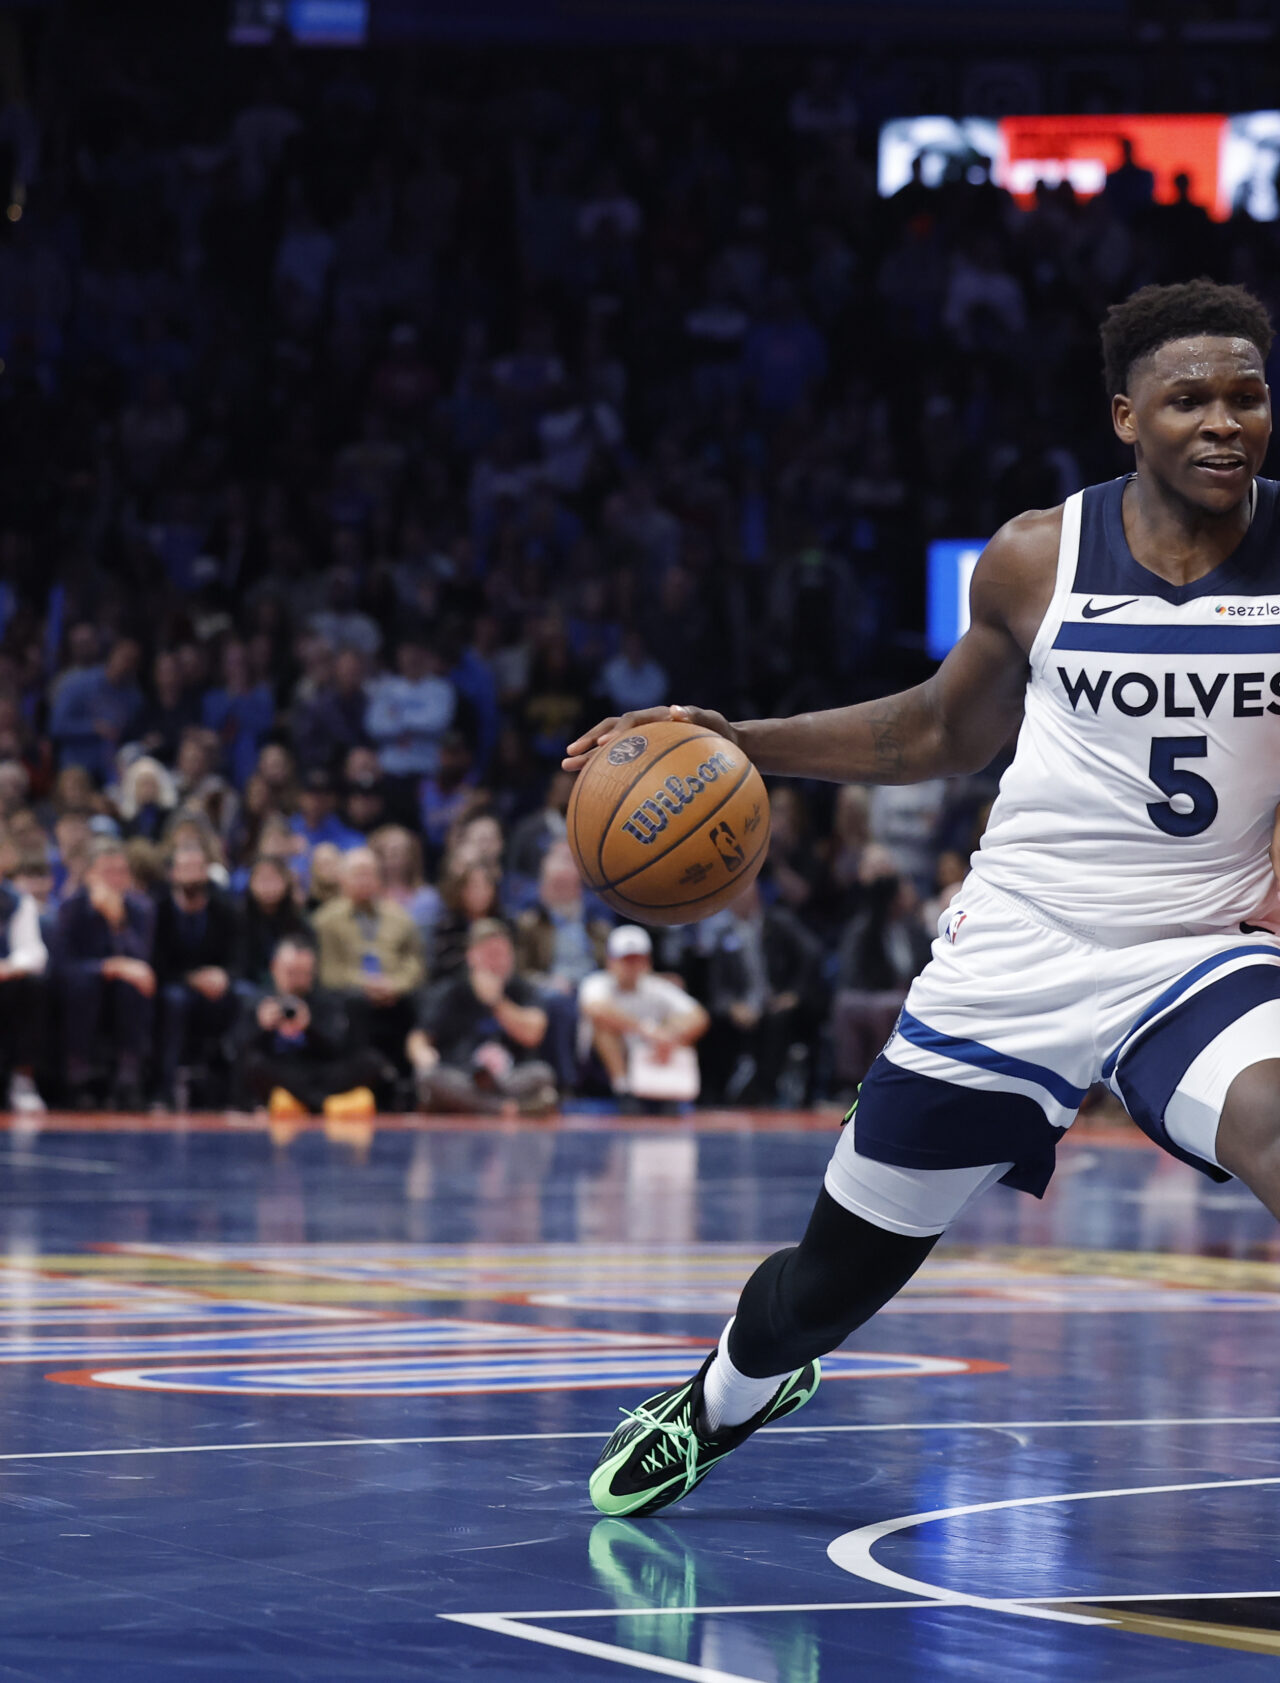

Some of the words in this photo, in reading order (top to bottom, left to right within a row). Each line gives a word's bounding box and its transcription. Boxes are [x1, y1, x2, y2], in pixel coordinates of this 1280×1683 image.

[1227, 602, 1280, 617] sezzle
[621, 751, 736, 845] Wilson
[1146, 735, 1219, 838] 5
